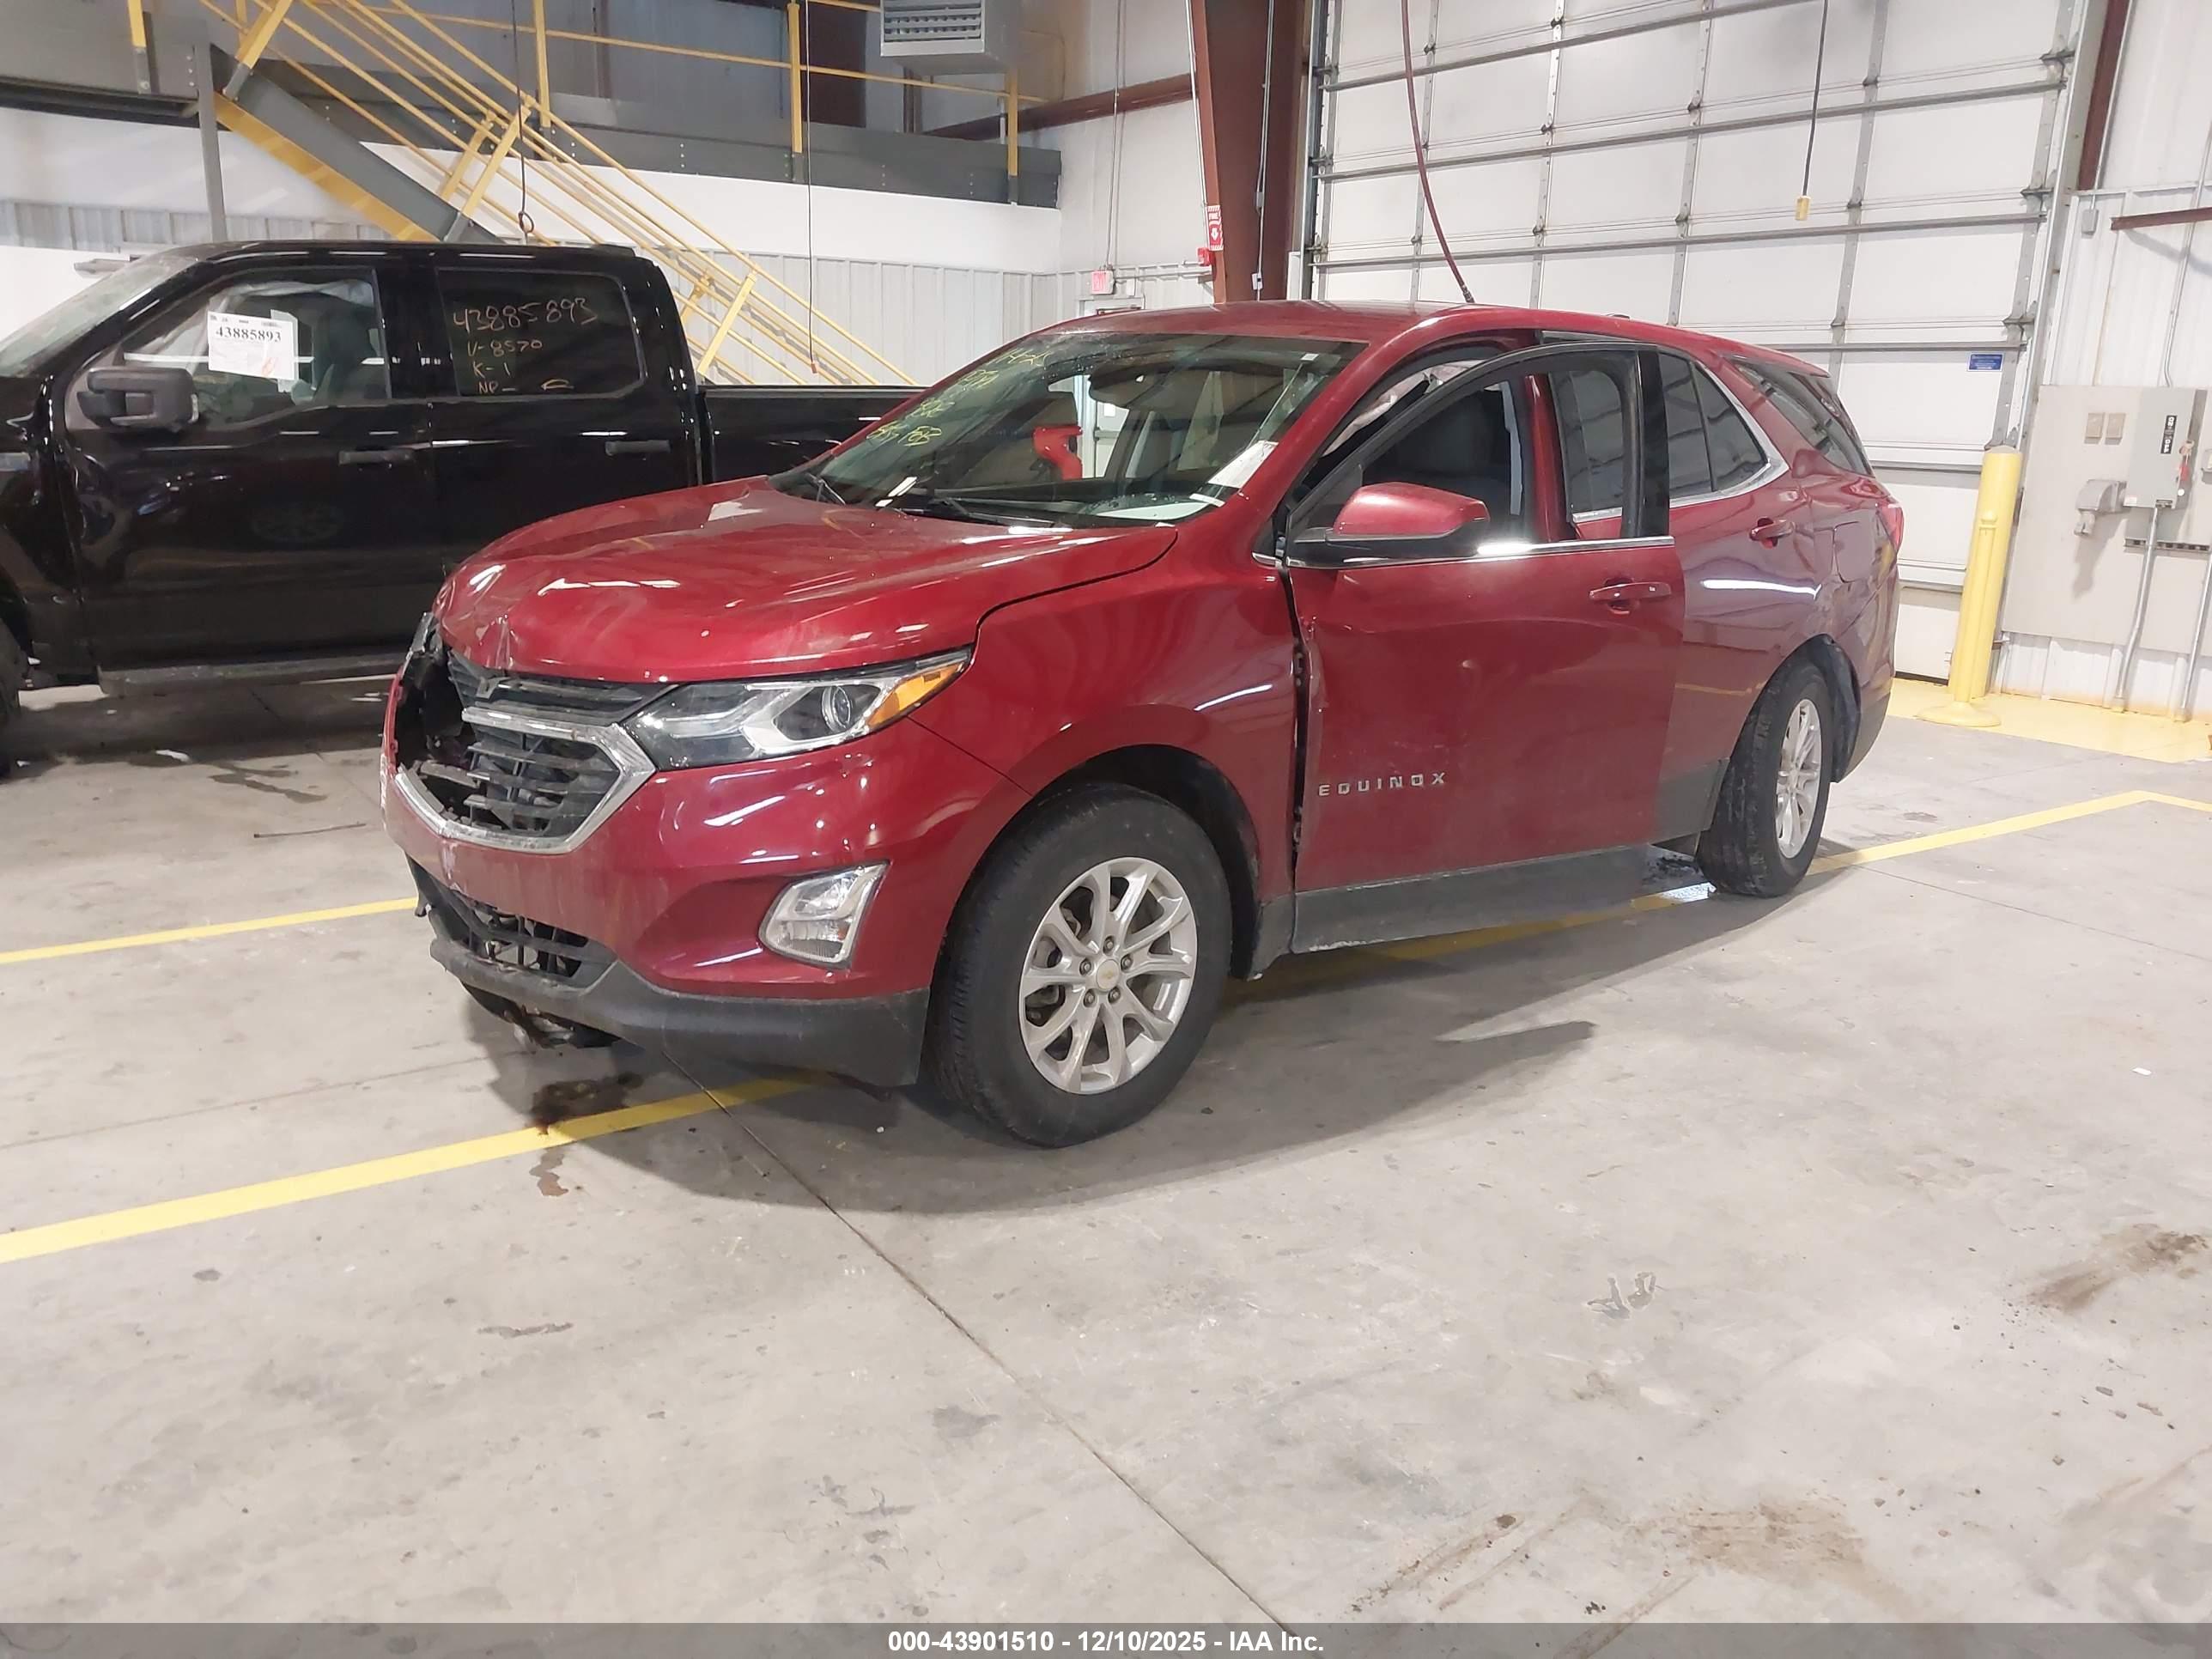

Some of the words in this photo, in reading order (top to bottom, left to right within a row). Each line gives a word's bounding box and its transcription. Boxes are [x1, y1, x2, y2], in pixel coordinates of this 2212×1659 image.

[453, 298, 599, 333] 43885893
[216, 326, 282, 343] 43885893
[1318, 772, 1445, 797] EQUINOX
